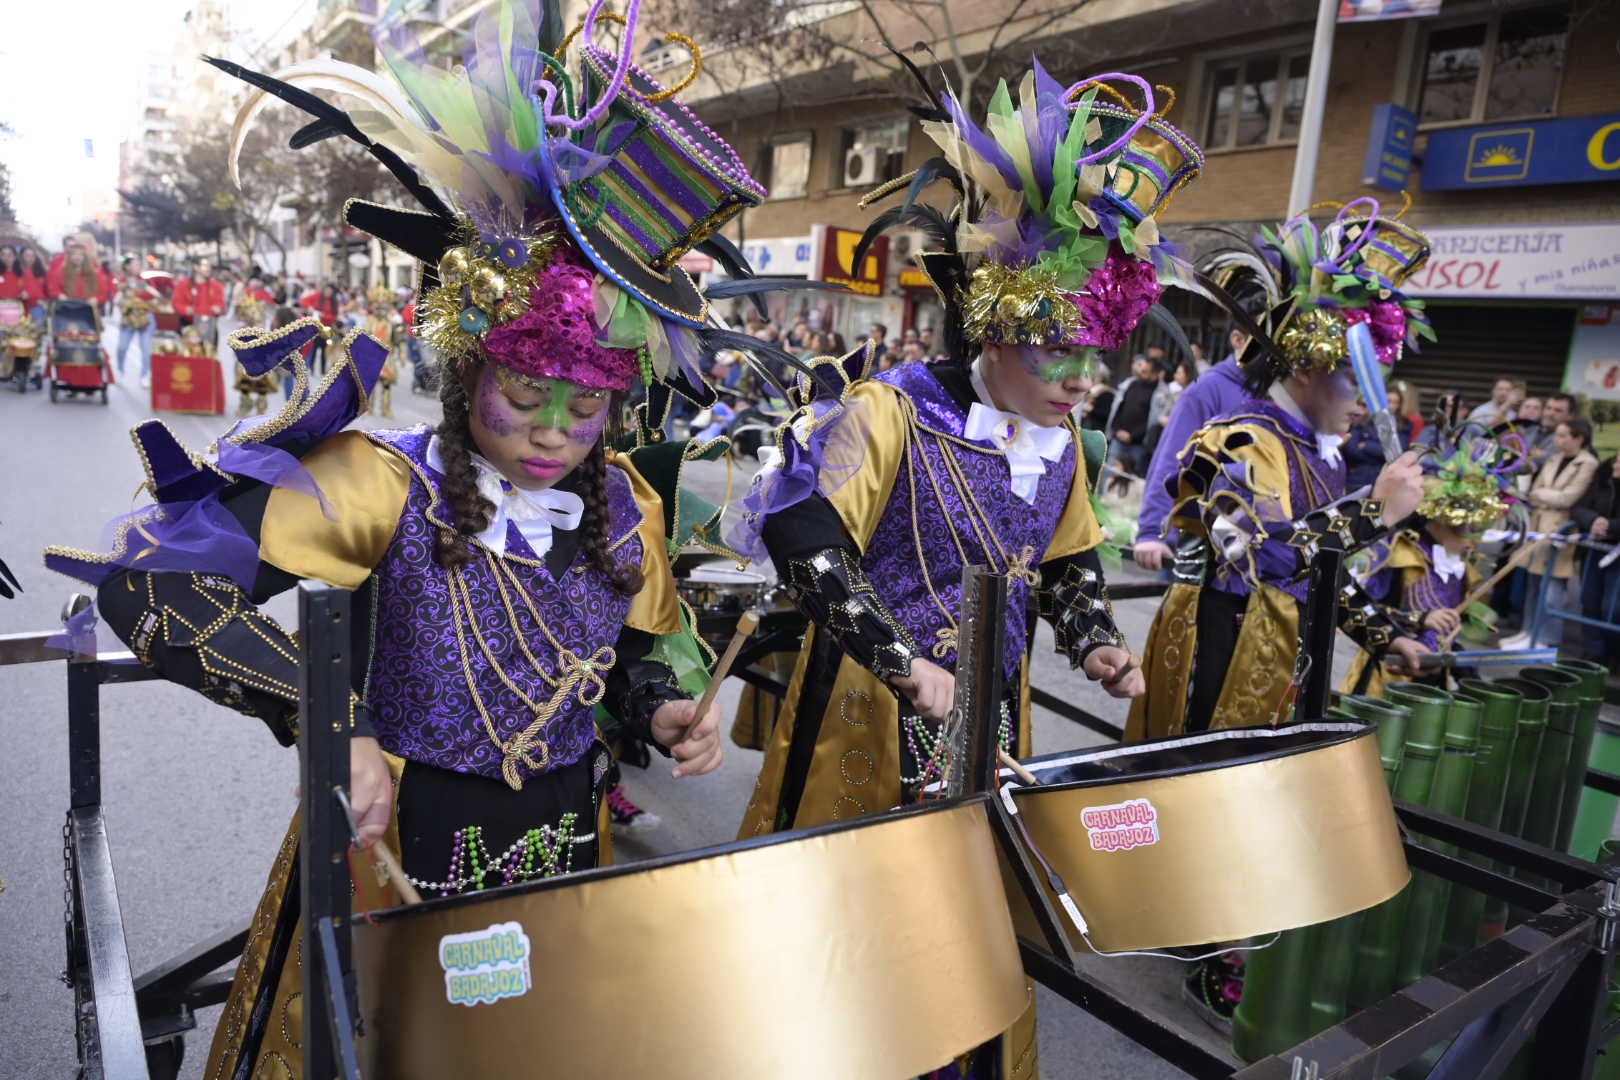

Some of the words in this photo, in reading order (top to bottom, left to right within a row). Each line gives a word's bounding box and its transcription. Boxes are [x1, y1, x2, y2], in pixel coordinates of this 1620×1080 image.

[1084, 803, 1154, 829] CARNAVAL
[1092, 827, 1154, 850] BADAJOZ
[444, 931, 525, 970] CARNAVAL
[449, 968, 523, 1003] BADAJOZ
